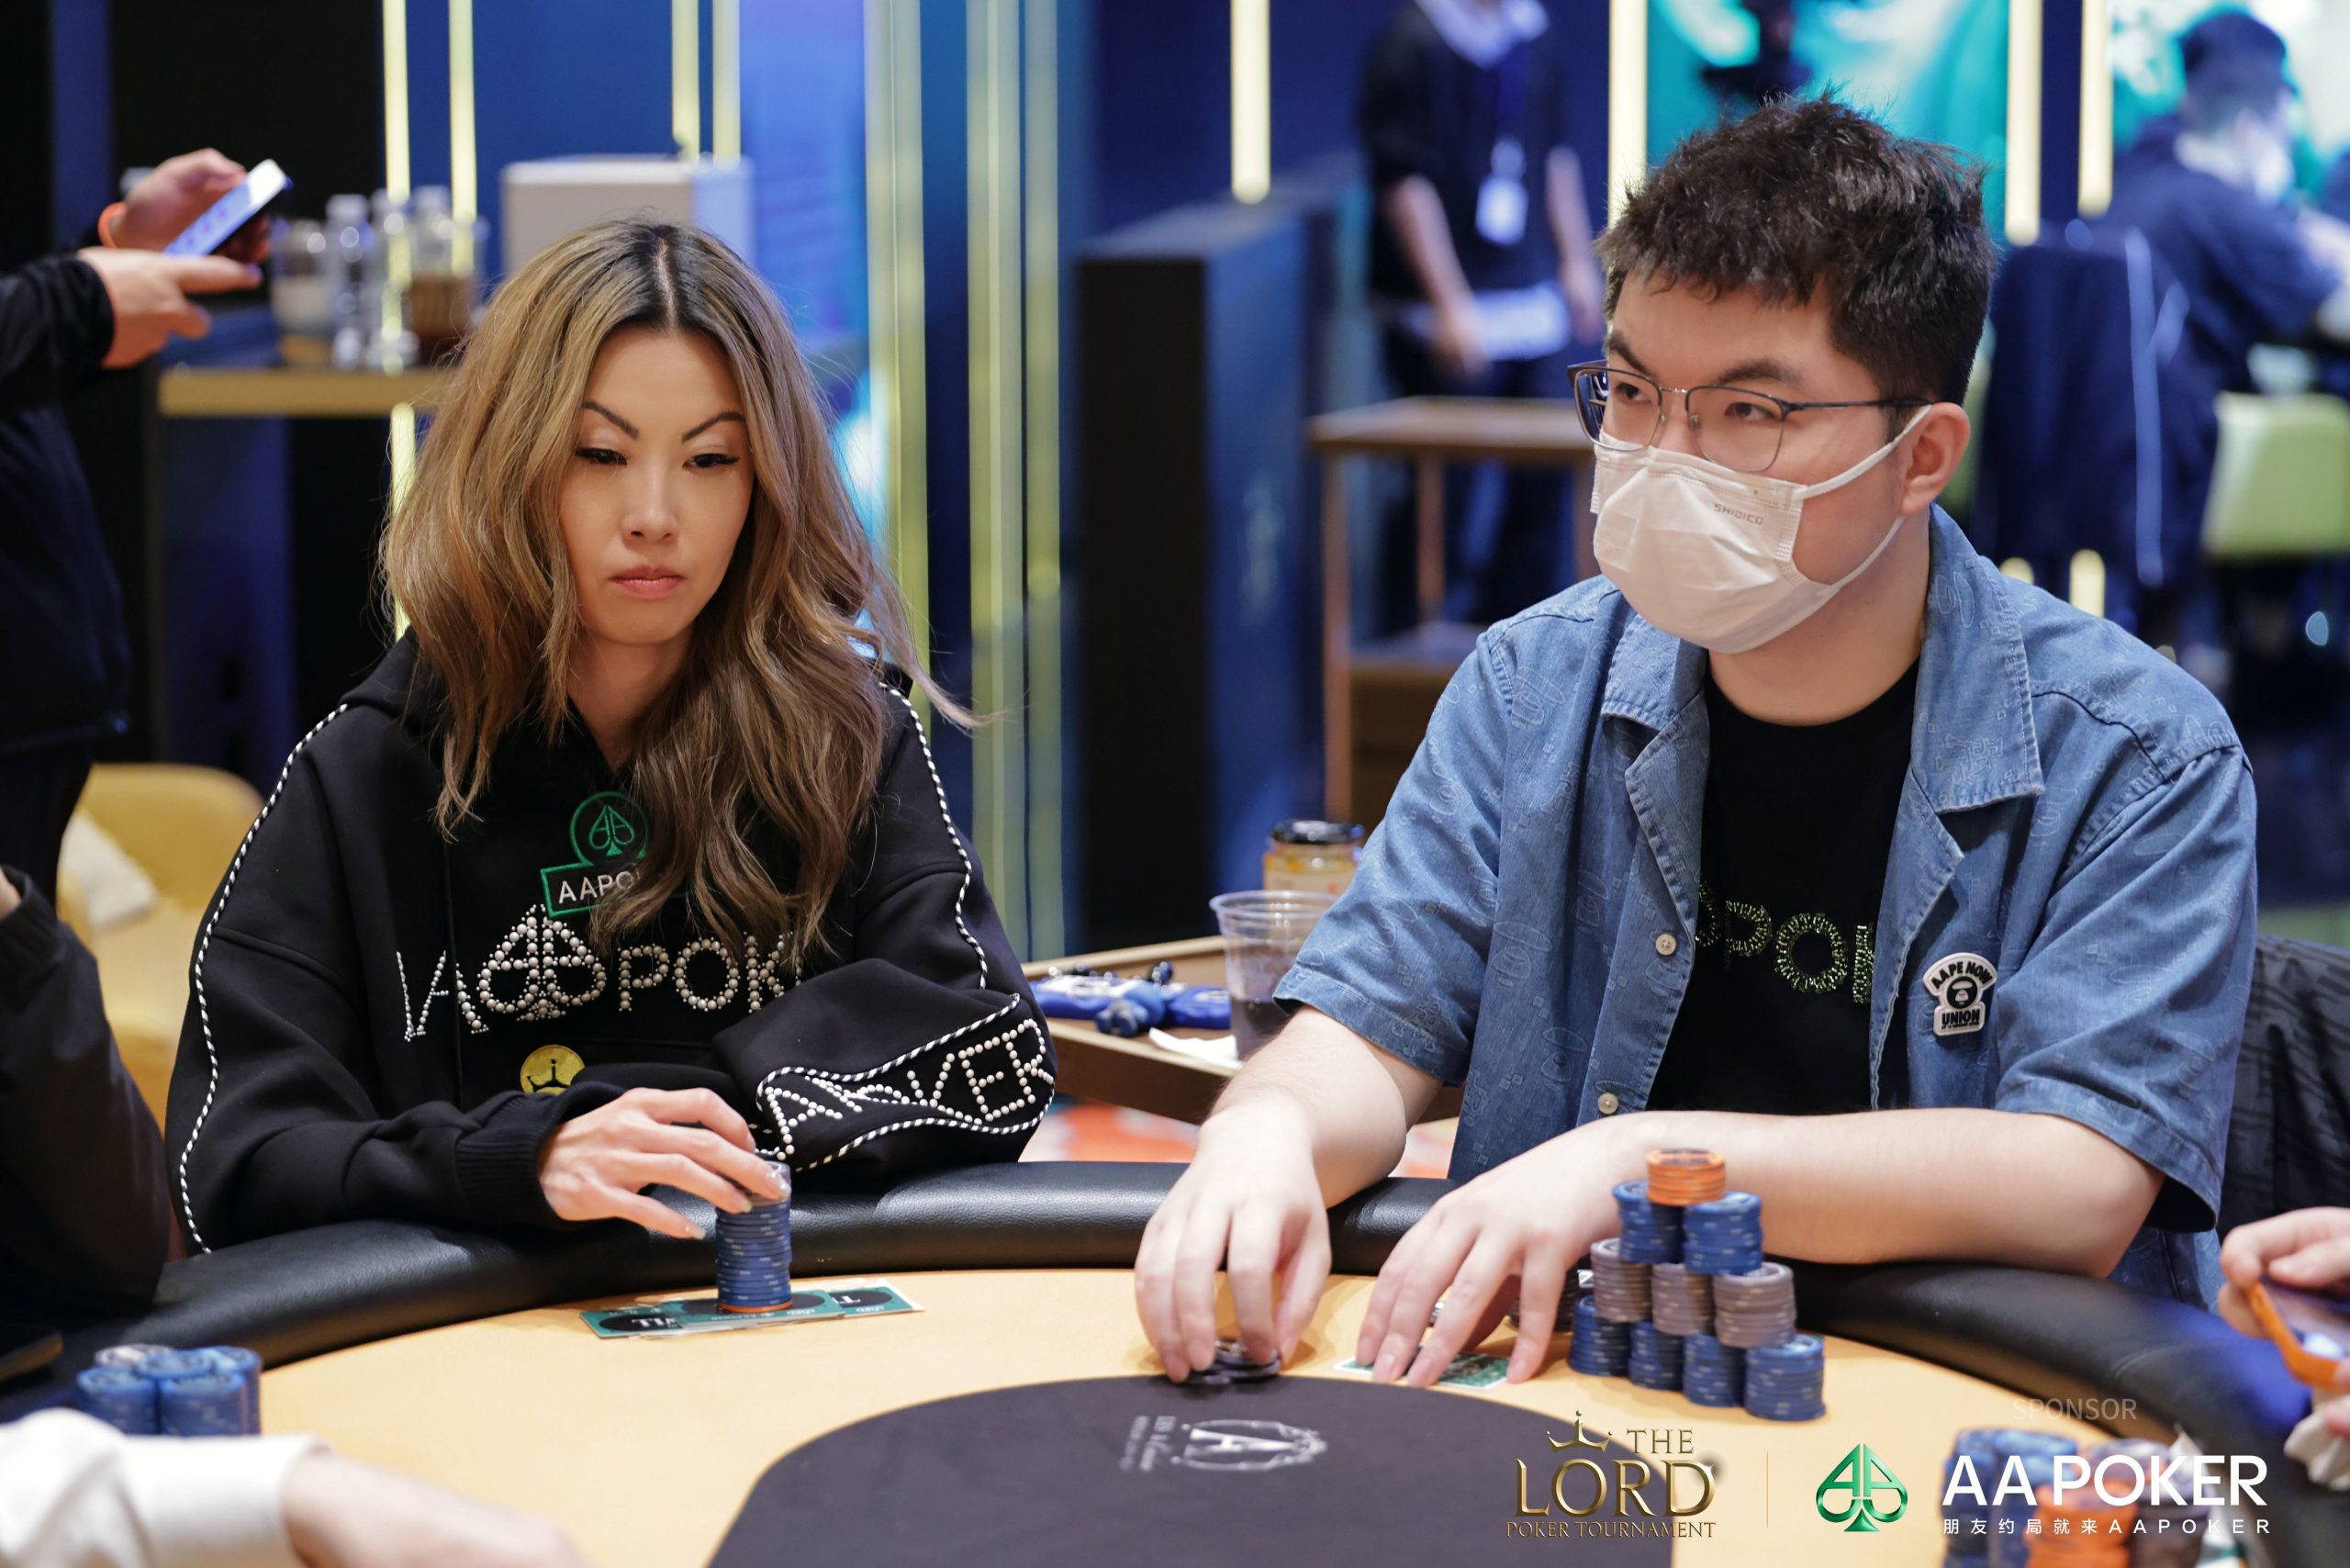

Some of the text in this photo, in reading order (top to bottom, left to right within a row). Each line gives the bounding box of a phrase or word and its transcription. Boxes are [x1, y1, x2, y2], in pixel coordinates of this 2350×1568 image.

[558, 869, 641, 904] AAPO
[1931, 960, 1993, 990] AAPE NOW
[1942, 1009, 1980, 1025] UNION
